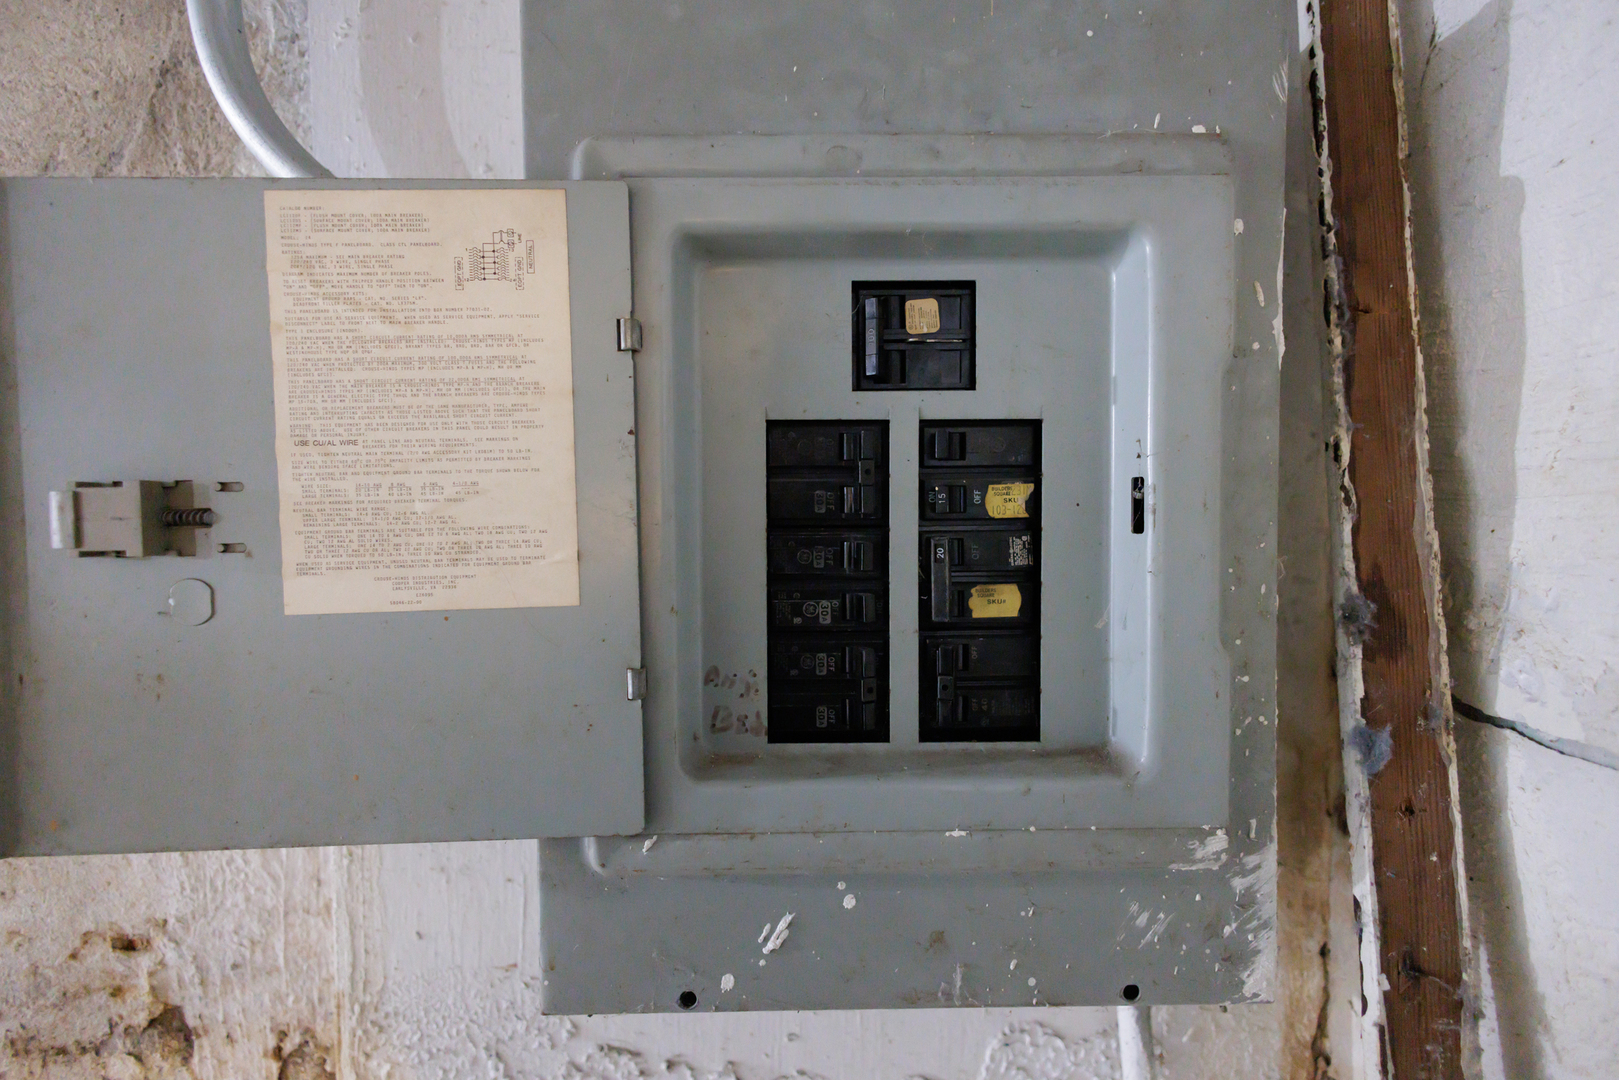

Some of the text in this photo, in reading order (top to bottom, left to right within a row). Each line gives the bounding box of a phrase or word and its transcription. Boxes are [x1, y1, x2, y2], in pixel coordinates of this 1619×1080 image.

[938, 493, 946, 504] 15
[974, 489, 982, 504] OFF
[936, 547, 945, 558] 20
[820, 602, 830, 623] 30A
[817, 655, 826, 675] 30A
[817, 707, 826, 726] 30A
[828, 709, 836, 724] OFF
